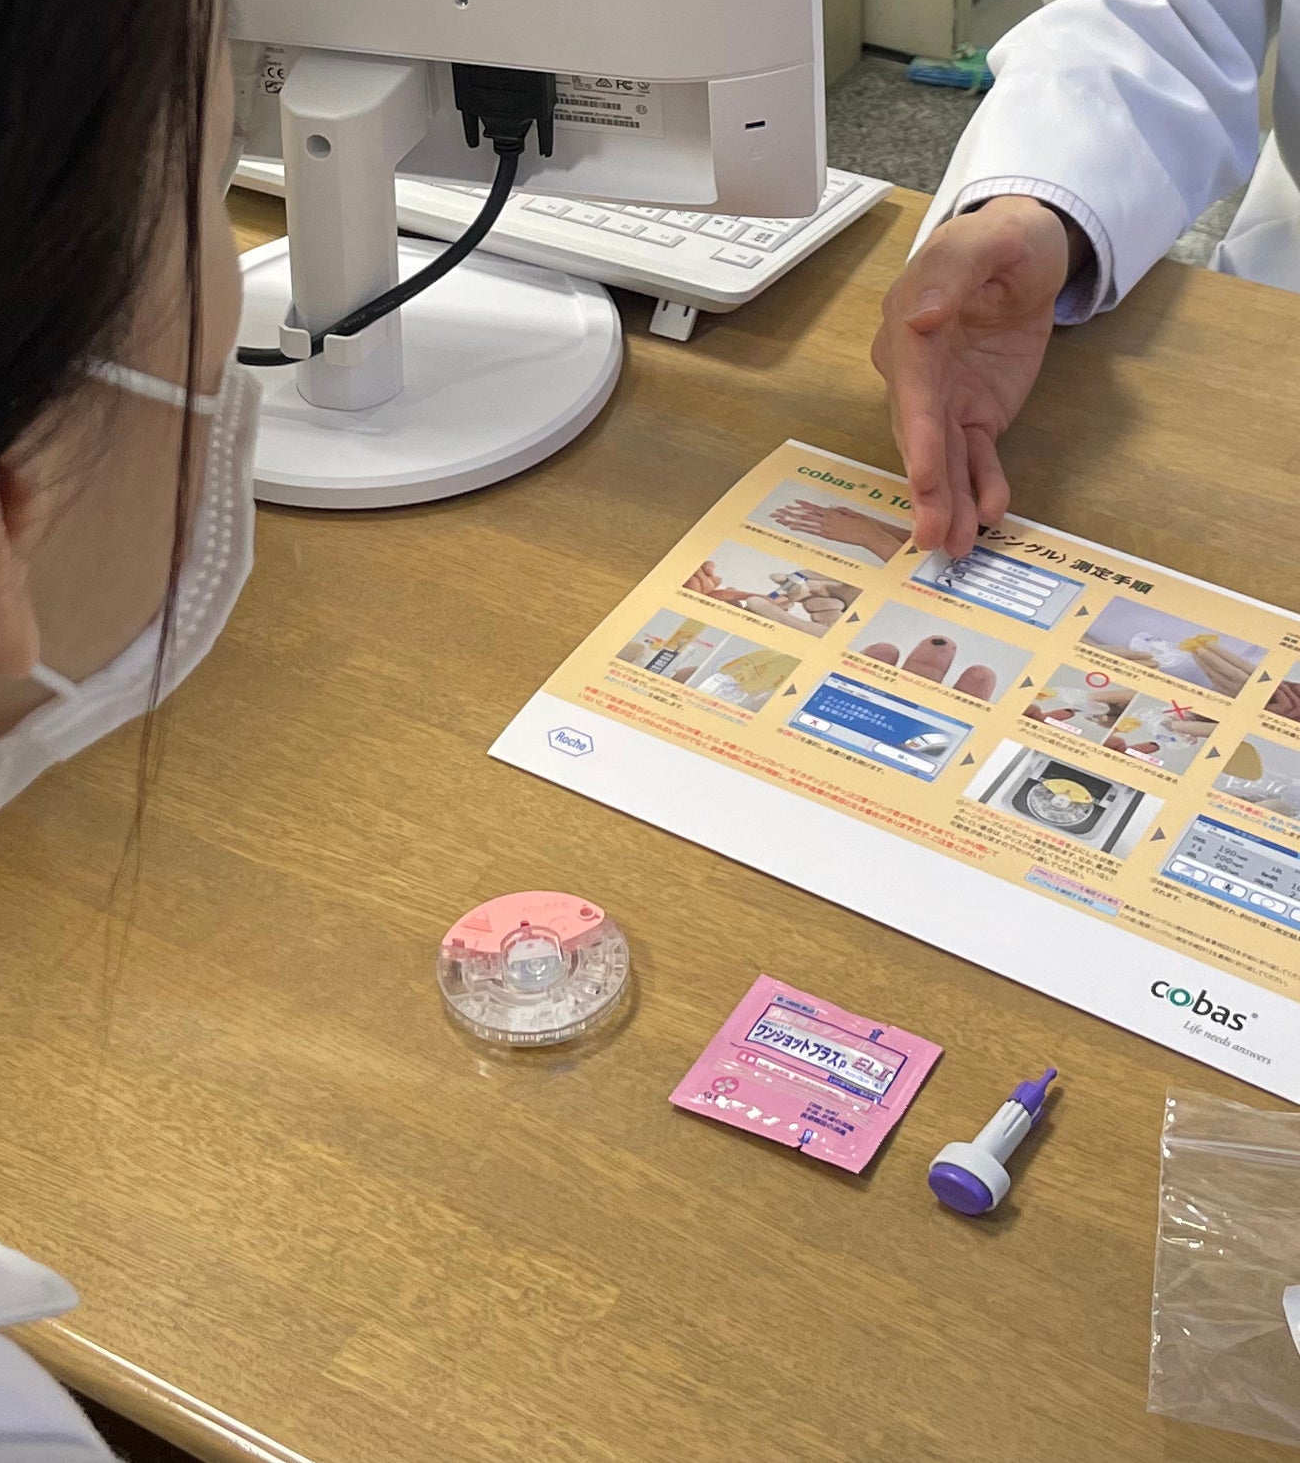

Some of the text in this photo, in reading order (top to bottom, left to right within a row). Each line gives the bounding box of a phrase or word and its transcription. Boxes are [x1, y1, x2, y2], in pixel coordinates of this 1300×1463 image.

[1069, 558, 1155, 595] 測定手順
[555, 731, 587, 751] Roche
[1183, 1020, 1272, 1065] Life needs answers
